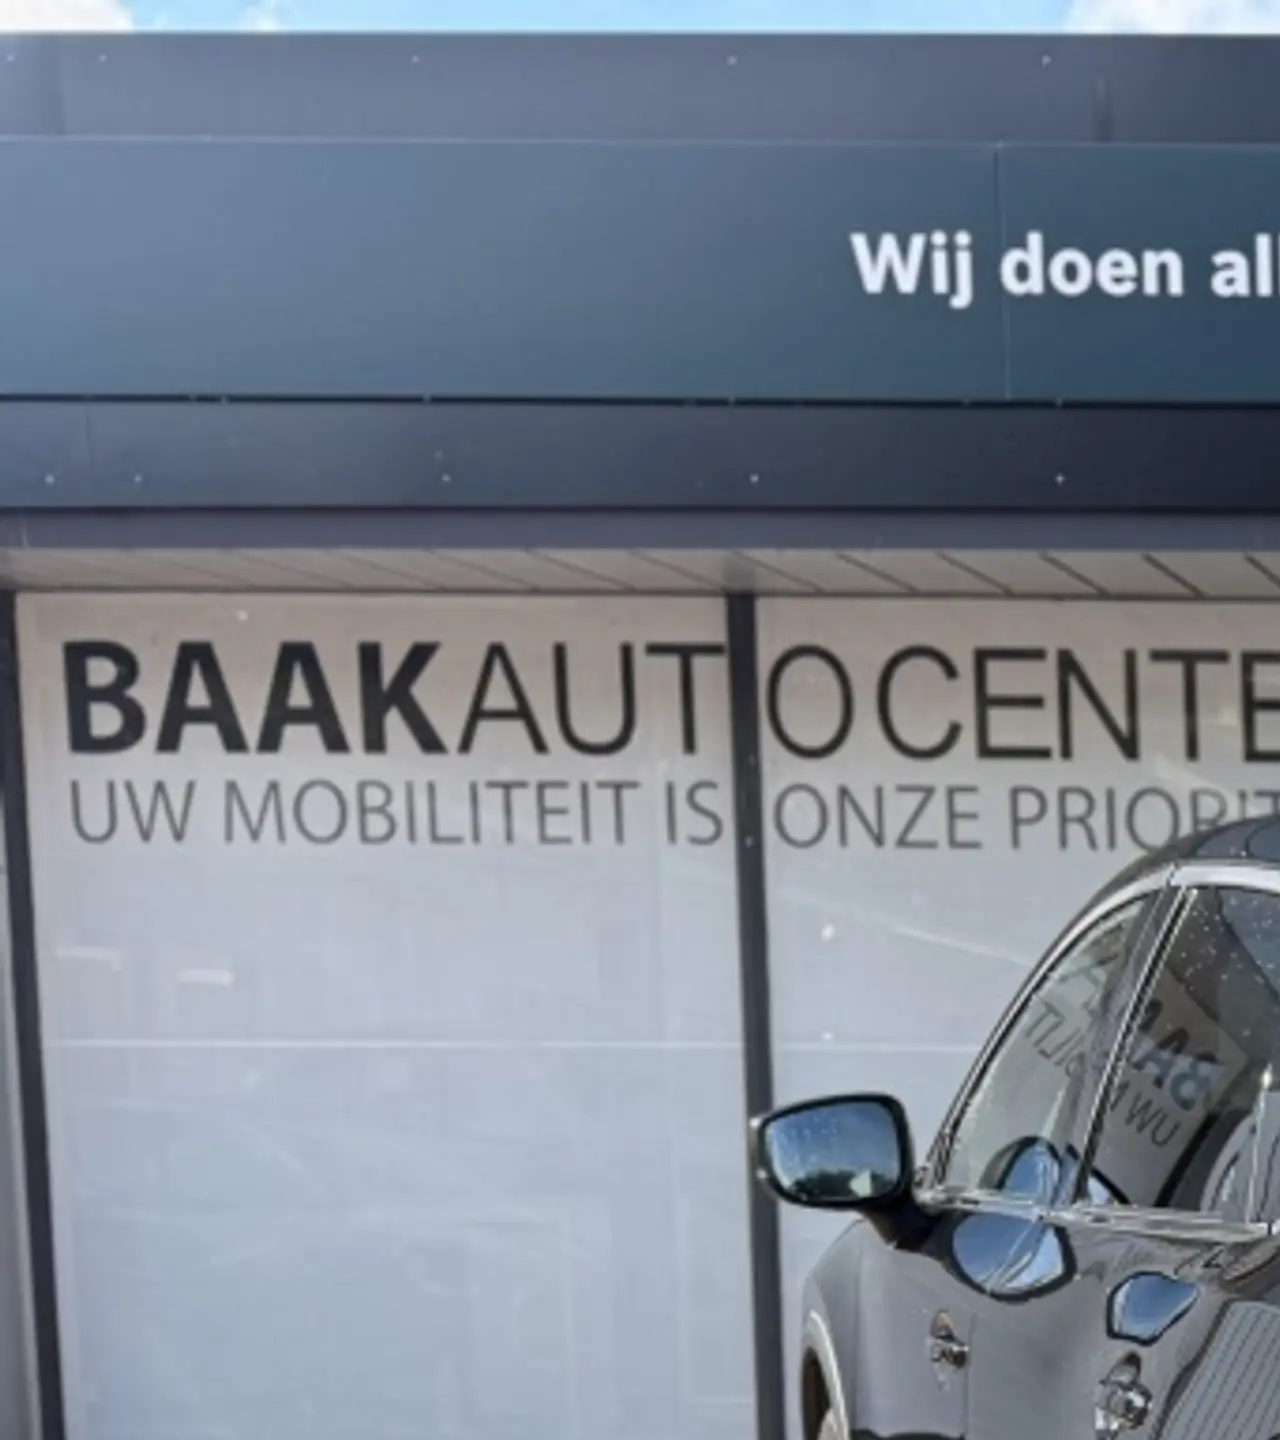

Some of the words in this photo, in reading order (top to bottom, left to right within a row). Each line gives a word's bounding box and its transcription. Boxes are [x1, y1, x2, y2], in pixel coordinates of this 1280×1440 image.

[852, 233, 975, 310] Wij
[1000, 234, 1184, 298] doen
[70, 779, 197, 844] UW
[223, 779, 641, 846] MOBILITEIT
[665, 781, 725, 846] IS
[774, 783, 982, 851] ONZE
